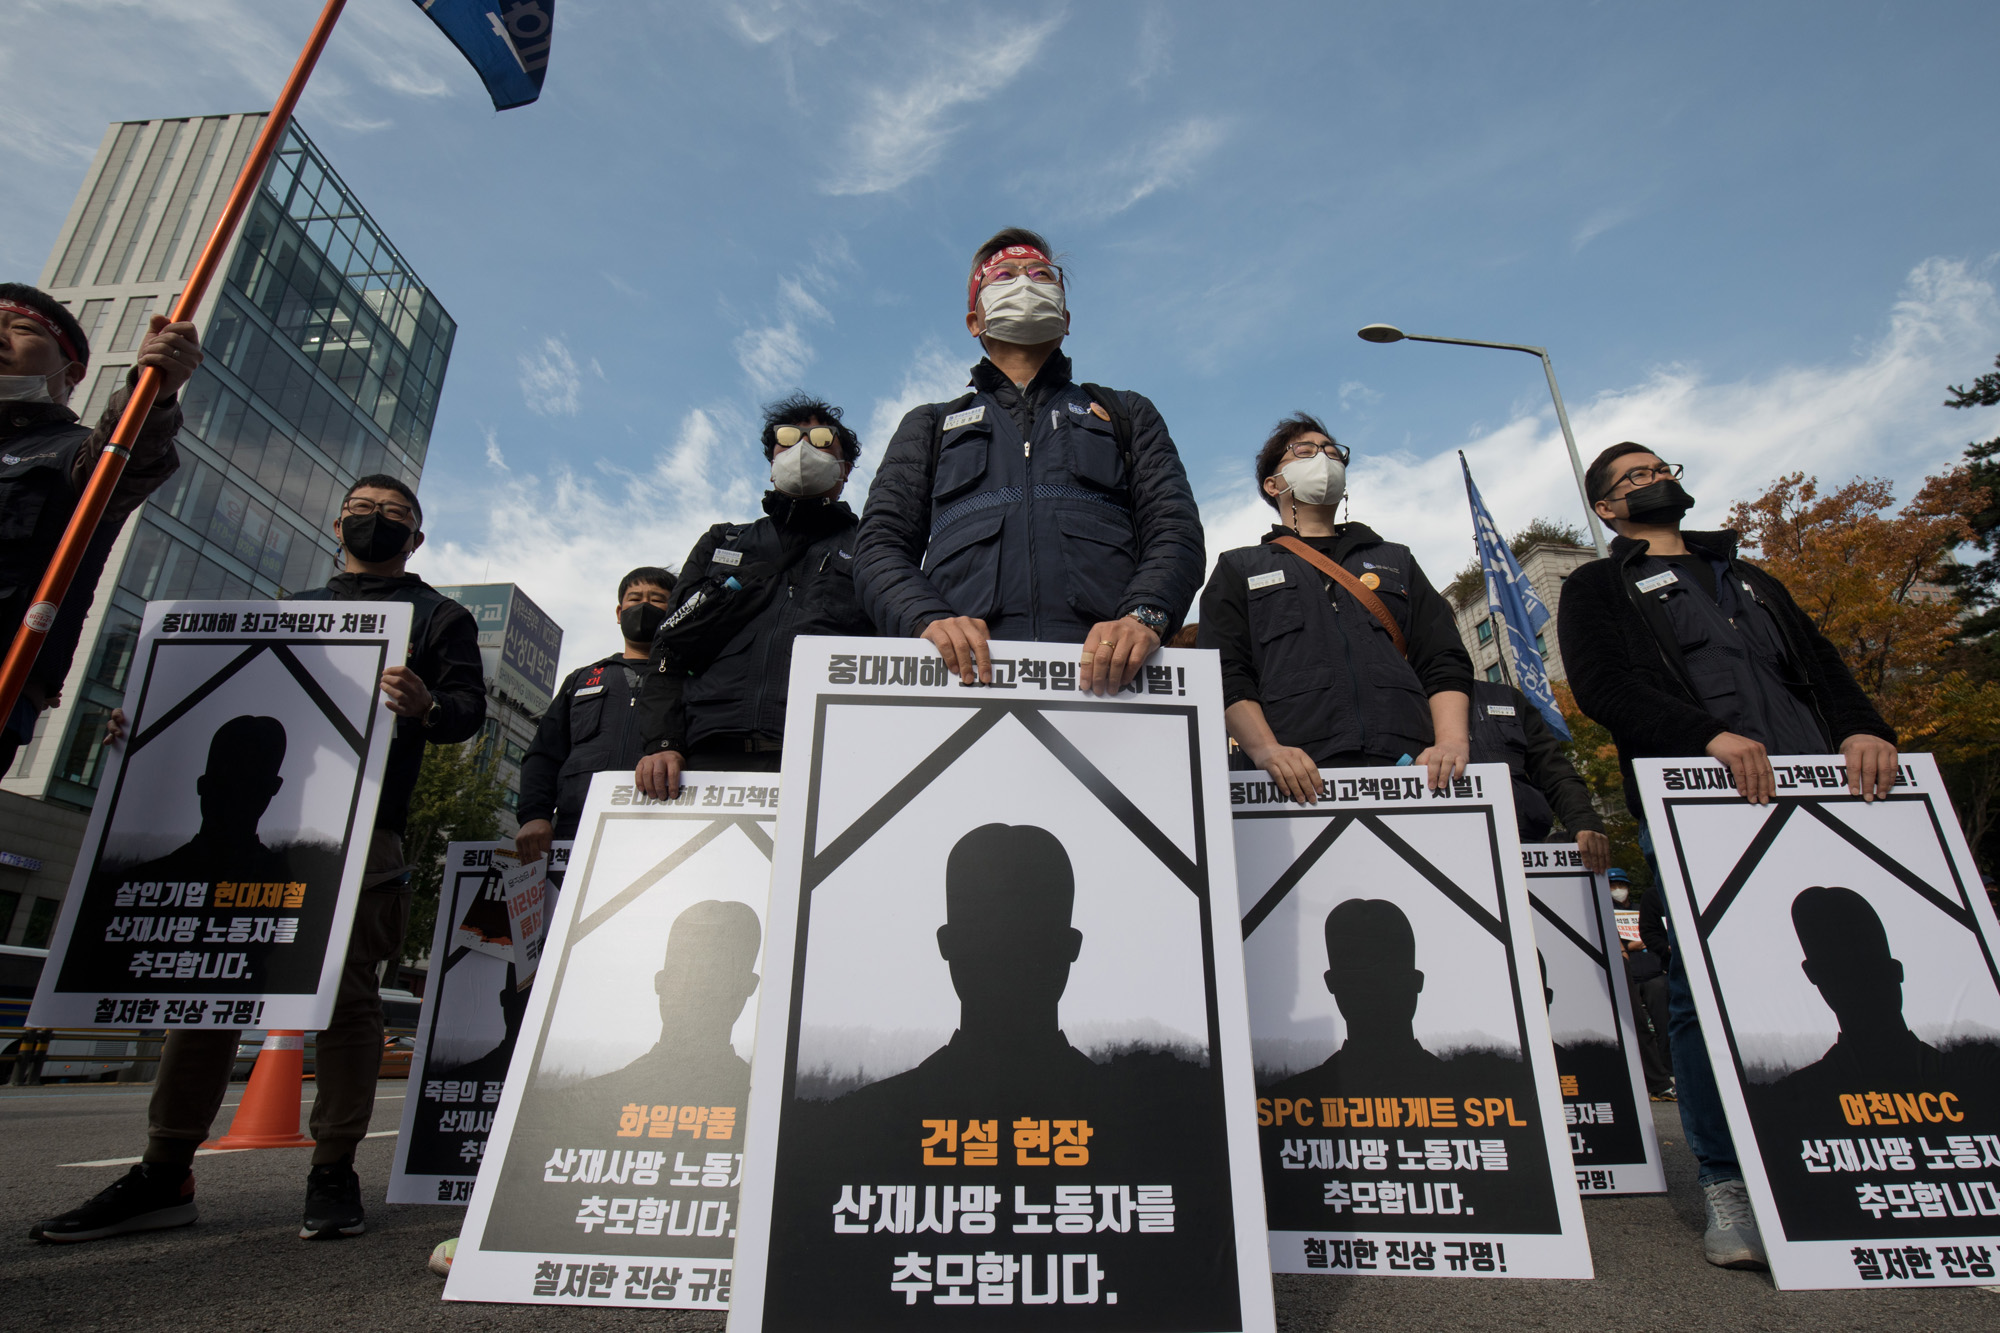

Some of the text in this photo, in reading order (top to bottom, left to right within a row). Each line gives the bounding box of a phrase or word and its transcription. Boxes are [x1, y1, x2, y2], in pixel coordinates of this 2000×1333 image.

[162, 613, 387, 634] 중대재해 최고책임자 처벌!
[828, 653, 949, 687] 중대재해
[115, 881, 307, 909] 살인기업 현대제철
[105, 916, 300, 943] 산재사망 노동자를
[129, 952, 253, 980] 추모합니다.
[95, 998, 265, 1026] 철저한 진상 규명!
[425, 1080, 506, 1103] 죽음의 공
[1838, 1091, 1965, 1126] 여천NCC
[617, 1103, 737, 1140] 화일약품
[1257, 1097, 1527, 1129] SPC 파리바게트 SPL
[920, 1117, 1094, 1167] 건설 현장
[1280, 1138, 1509, 1171] 산재사망 노동자를
[1801, 1137, 1916, 1173] 산재사망
[543, 1148, 667, 1186] 산재사망
[438, 1180, 477, 1201] 철저
[1323, 1181, 1475, 1215] 추모합니다.
[575, 1195, 738, 1238] 추모합니다.
[831, 1184, 1177, 1235] 산재사망 노동자를
[1303, 1238, 1507, 1273] 철저한 진상 규명!
[1850, 1245, 1996, 1281] 철저한 진상
[533, 1260, 620, 1299] 철저한
[624, 1265, 683, 1301] 진상
[890, 1252, 1118, 1306] 추모합니다.
